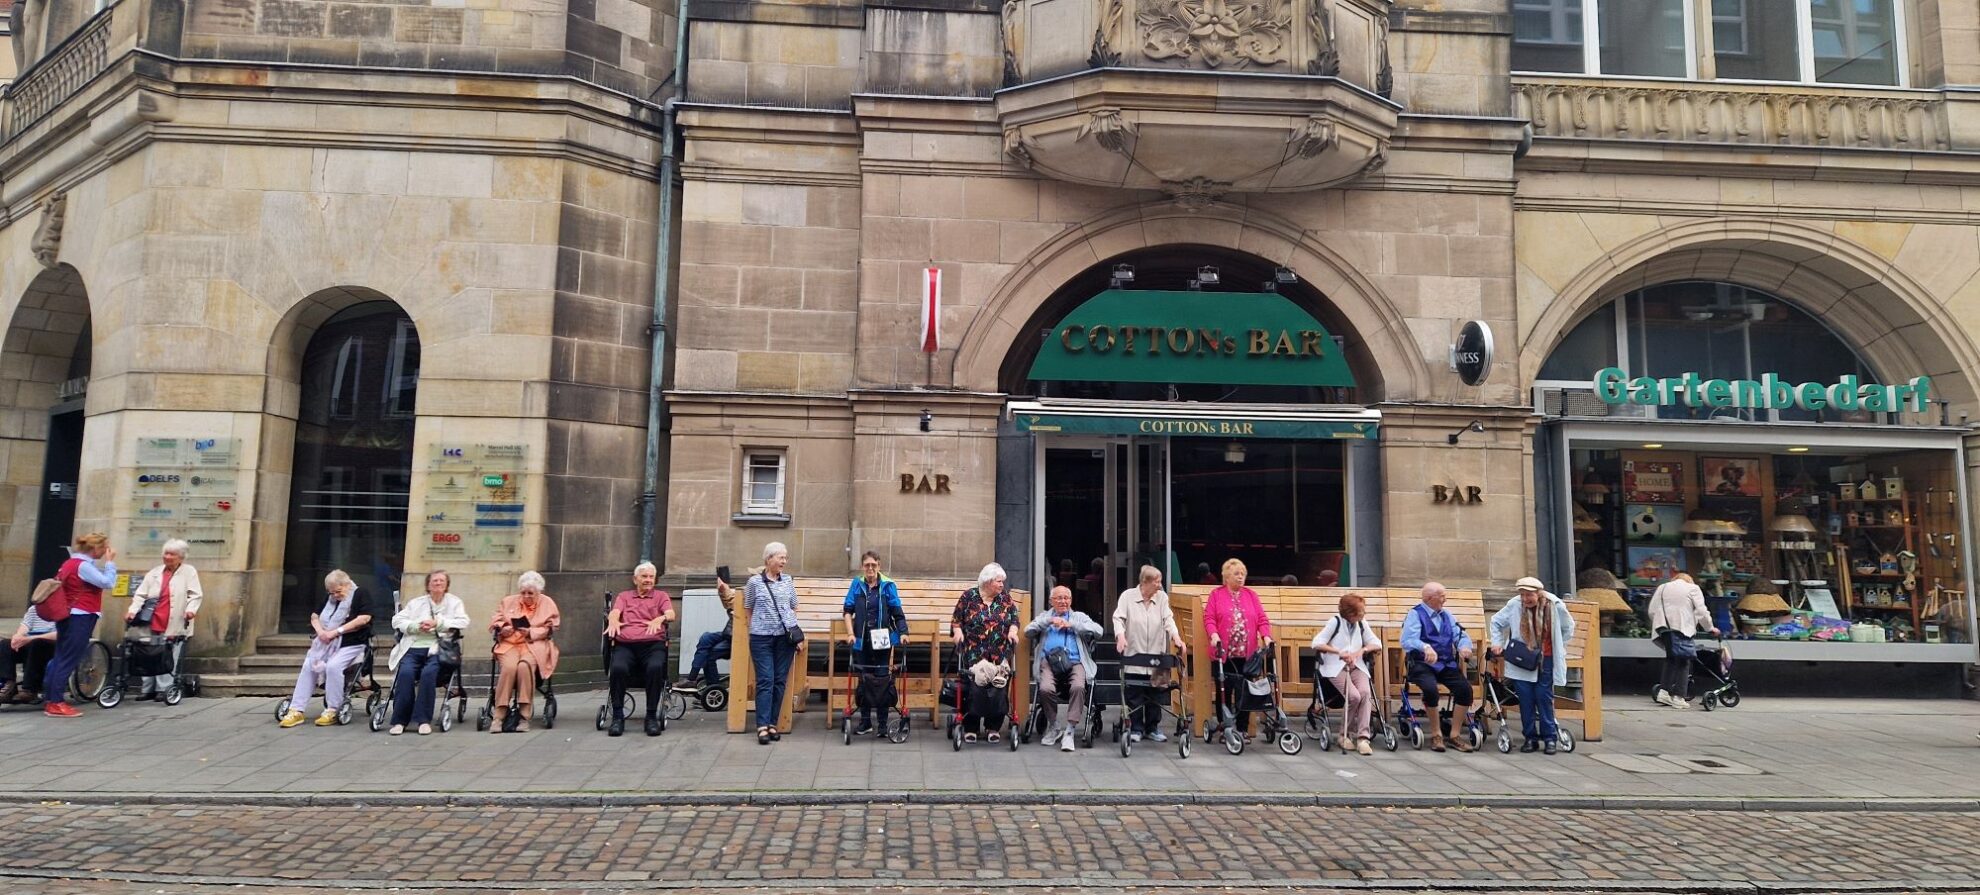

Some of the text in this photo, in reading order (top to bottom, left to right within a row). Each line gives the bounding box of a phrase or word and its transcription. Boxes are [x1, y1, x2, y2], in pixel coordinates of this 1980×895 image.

[1060, 324, 1326, 357] COTTONs BAR
[1594, 366, 1931, 413] Gartenbedarf
[1140, 420, 1254, 434] COTTONs BAR
[149, 474, 180, 483] DELFS
[900, 473, 951, 494] BAR
[1639, 478, 1670, 487] HOME
[1432, 484, 1484, 504] BAR
[432, 533, 462, 543] ERGO
